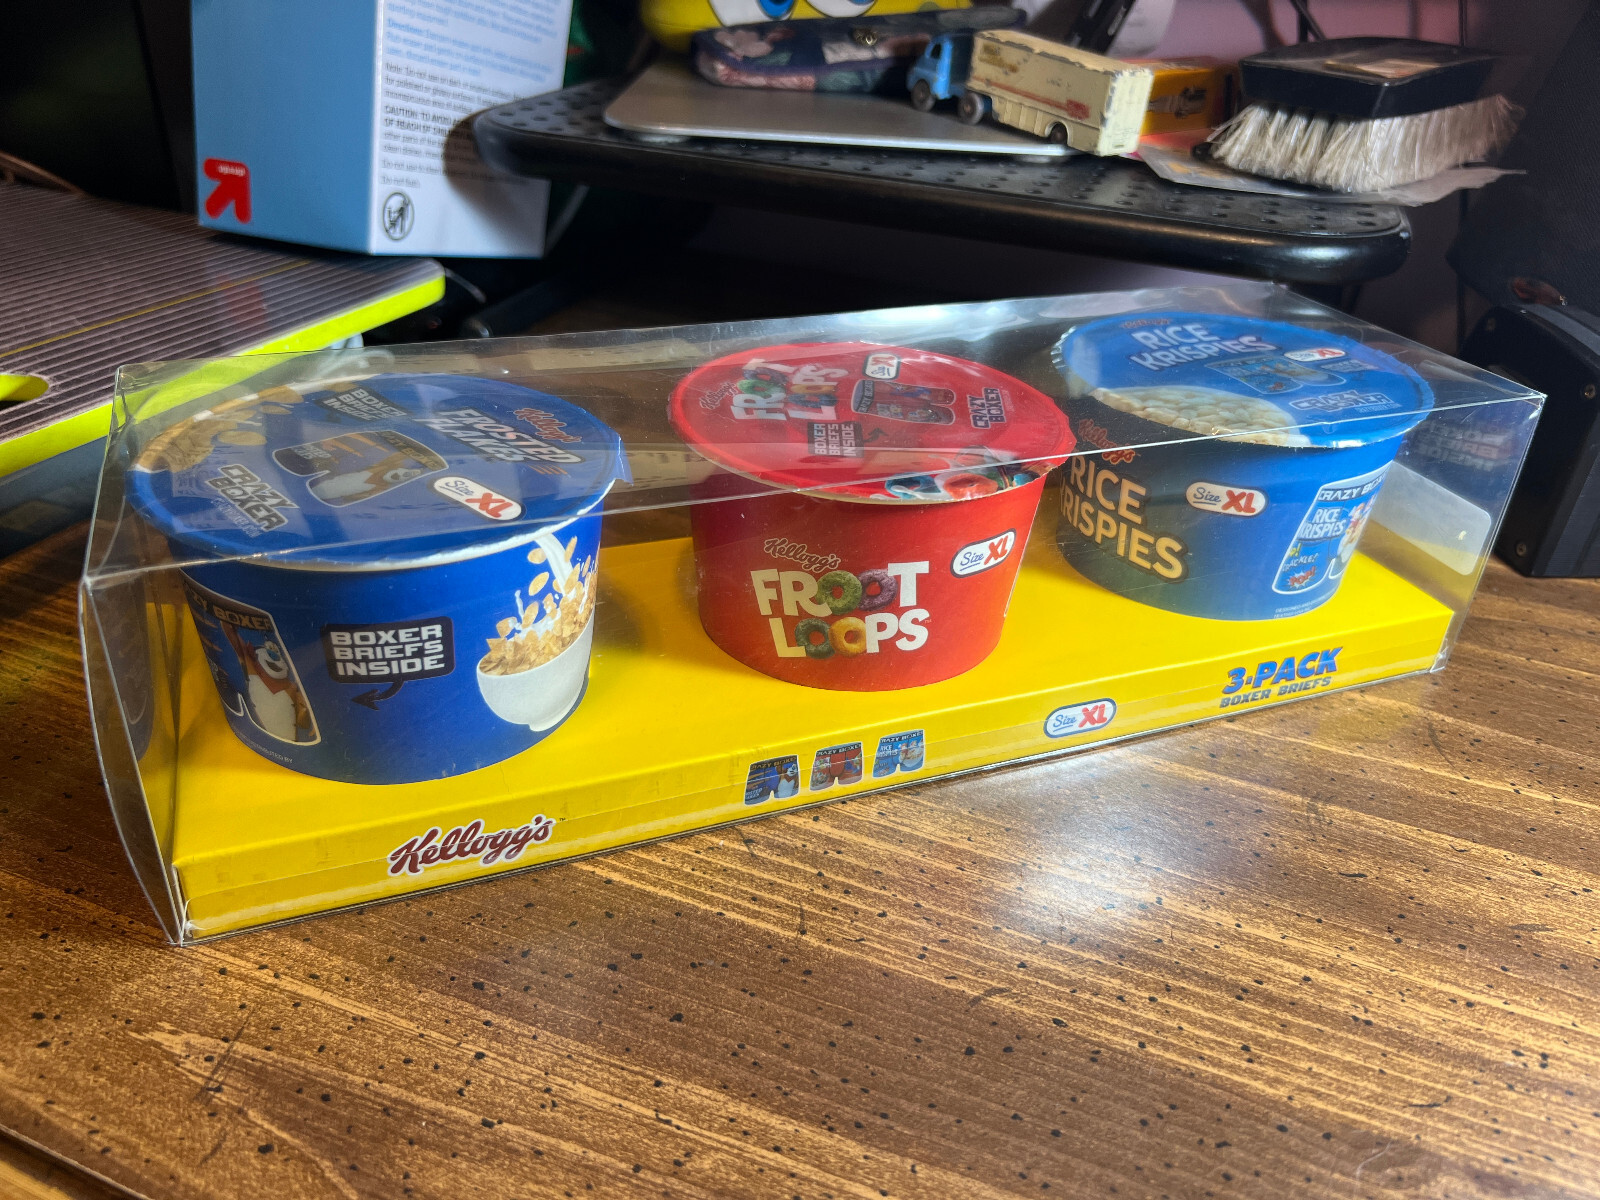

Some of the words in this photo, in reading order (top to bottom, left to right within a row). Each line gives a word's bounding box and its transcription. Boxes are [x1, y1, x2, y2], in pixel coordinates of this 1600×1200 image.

[1130, 336, 1278, 371] KRISPIES
[1131, 323, 1221, 350] RICE
[351, 388, 407, 416] BOXER
[730, 358, 799, 421] FROOT
[787, 364, 849, 421] LOOPS
[983, 386, 1007, 423] BOXER
[513, 408, 583, 443] Kellogg's
[968, 395, 991, 429] CRAZY
[412, 418, 539, 462] FLAKES
[438, 408, 583, 463] FROSTED
[814, 423, 828, 455] BOXER
[828, 423, 841, 456] BRIEFS
[841, 423, 857, 457] INSIDE
[218, 464, 299, 508] CRAZY
[445, 480, 474, 496] Size
[465, 493, 514, 518] XL
[1070, 455, 1147, 525] RICE
[1192, 486, 1222, 503] Size
[1221, 489, 1257, 514] XL
[1318, 487, 1361, 501] CRAZY
[205, 476, 288, 532] BOXER
[1312, 508, 1342, 523] RICE
[763, 537, 841, 571] Kellogg's
[960, 551, 985, 567] Size
[984, 534, 1009, 565] XL
[750, 560, 930, 617] FROOT
[330, 624, 442, 646] BOXER
[333, 640, 443, 660] BRIEFS
[769, 608, 930, 659] LOOPS
[336, 654, 445, 676] INSIDE
[1222, 646, 1343, 694] 3-PACK
[1220, 689, 1272, 708] BOXER
[1277, 676, 1332, 696] BRIEFS
[1053, 714, 1077, 728] Size
[1078, 704, 1108, 728] XL
[388, 814, 556, 876] Kellogg's
